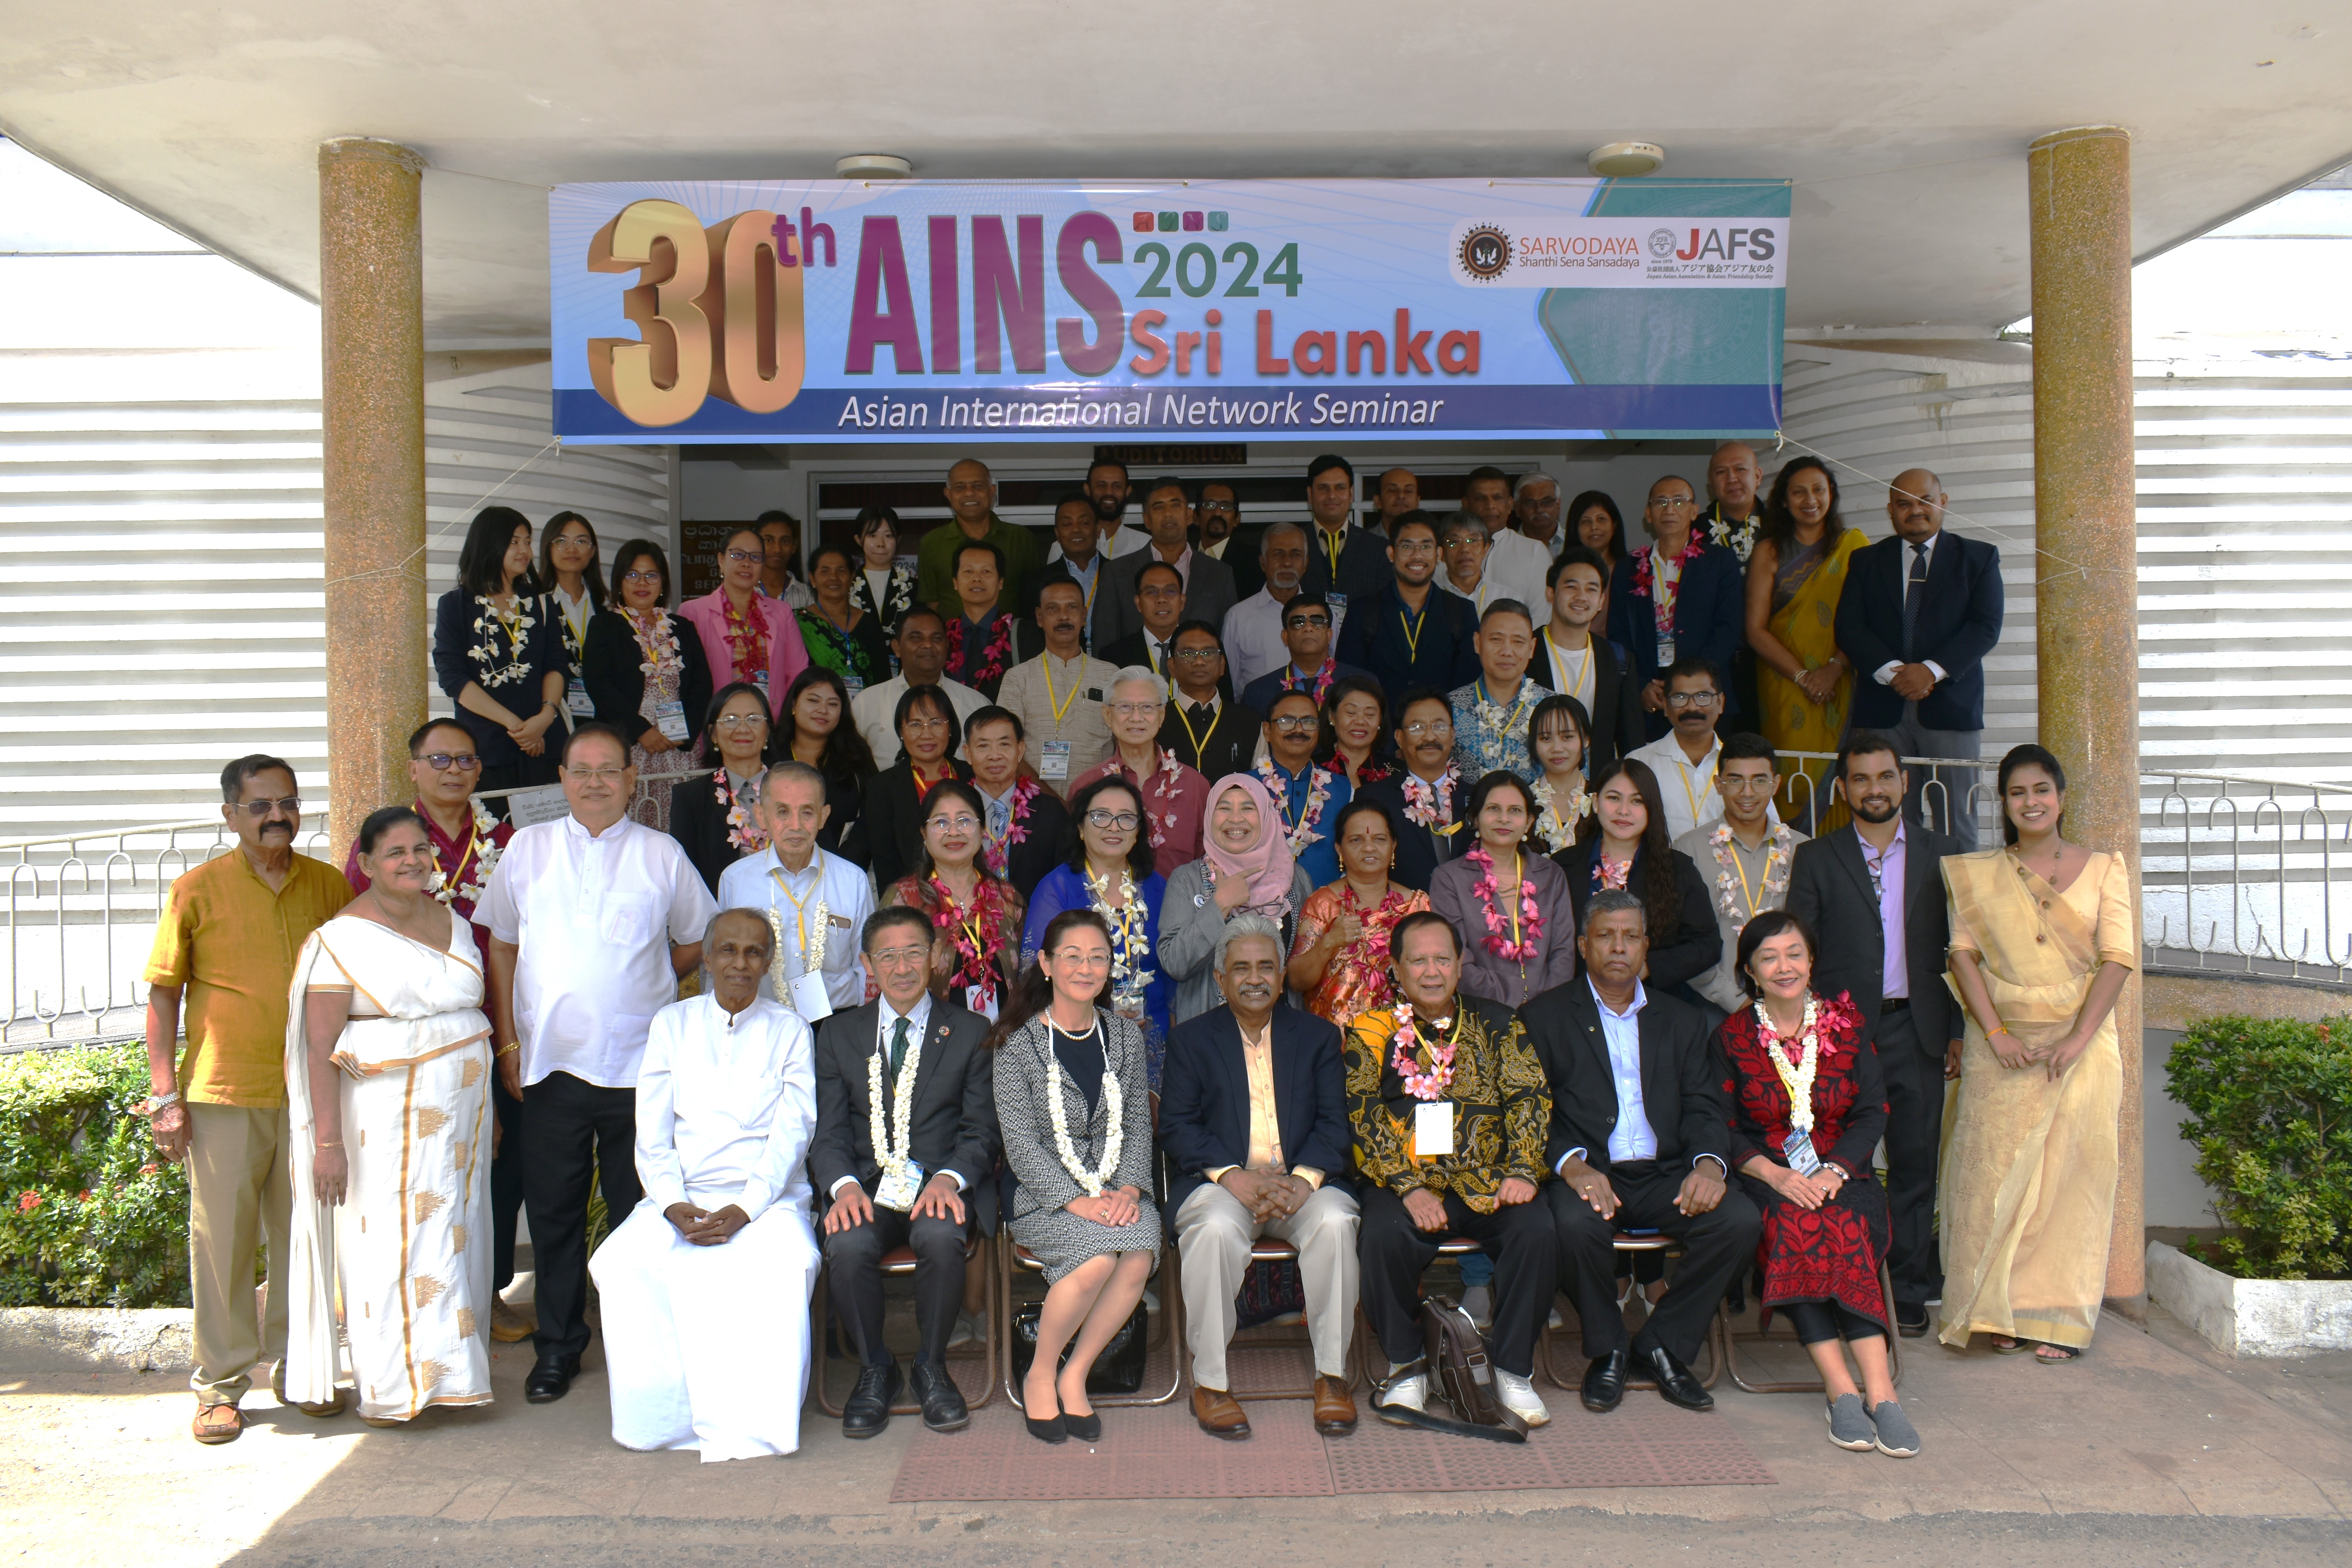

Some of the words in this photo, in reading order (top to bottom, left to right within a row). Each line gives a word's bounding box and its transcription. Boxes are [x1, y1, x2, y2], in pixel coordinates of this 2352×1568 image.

[1519, 237, 1639, 255] SARVODAYA
[1676, 228, 1775, 261] JAFS
[1133, 242, 1303, 298] 2024
[1519, 257, 1558, 267] Shanthi
[1560, 257, 1584, 267] Sena
[1587, 256, 1639, 269] Sansadaya
[844, 210, 1125, 377] AINS
[1130, 309, 1222, 374] Sri
[1257, 308, 1480, 374] Lanka
[838, 396, 928, 427] Asian
[940, 392, 1153, 426] International
[1162, 392, 1302, 425] Network
[1310, 393, 1444, 424] Seminar
[1100, 446, 1243, 463] AUDITORIUM
